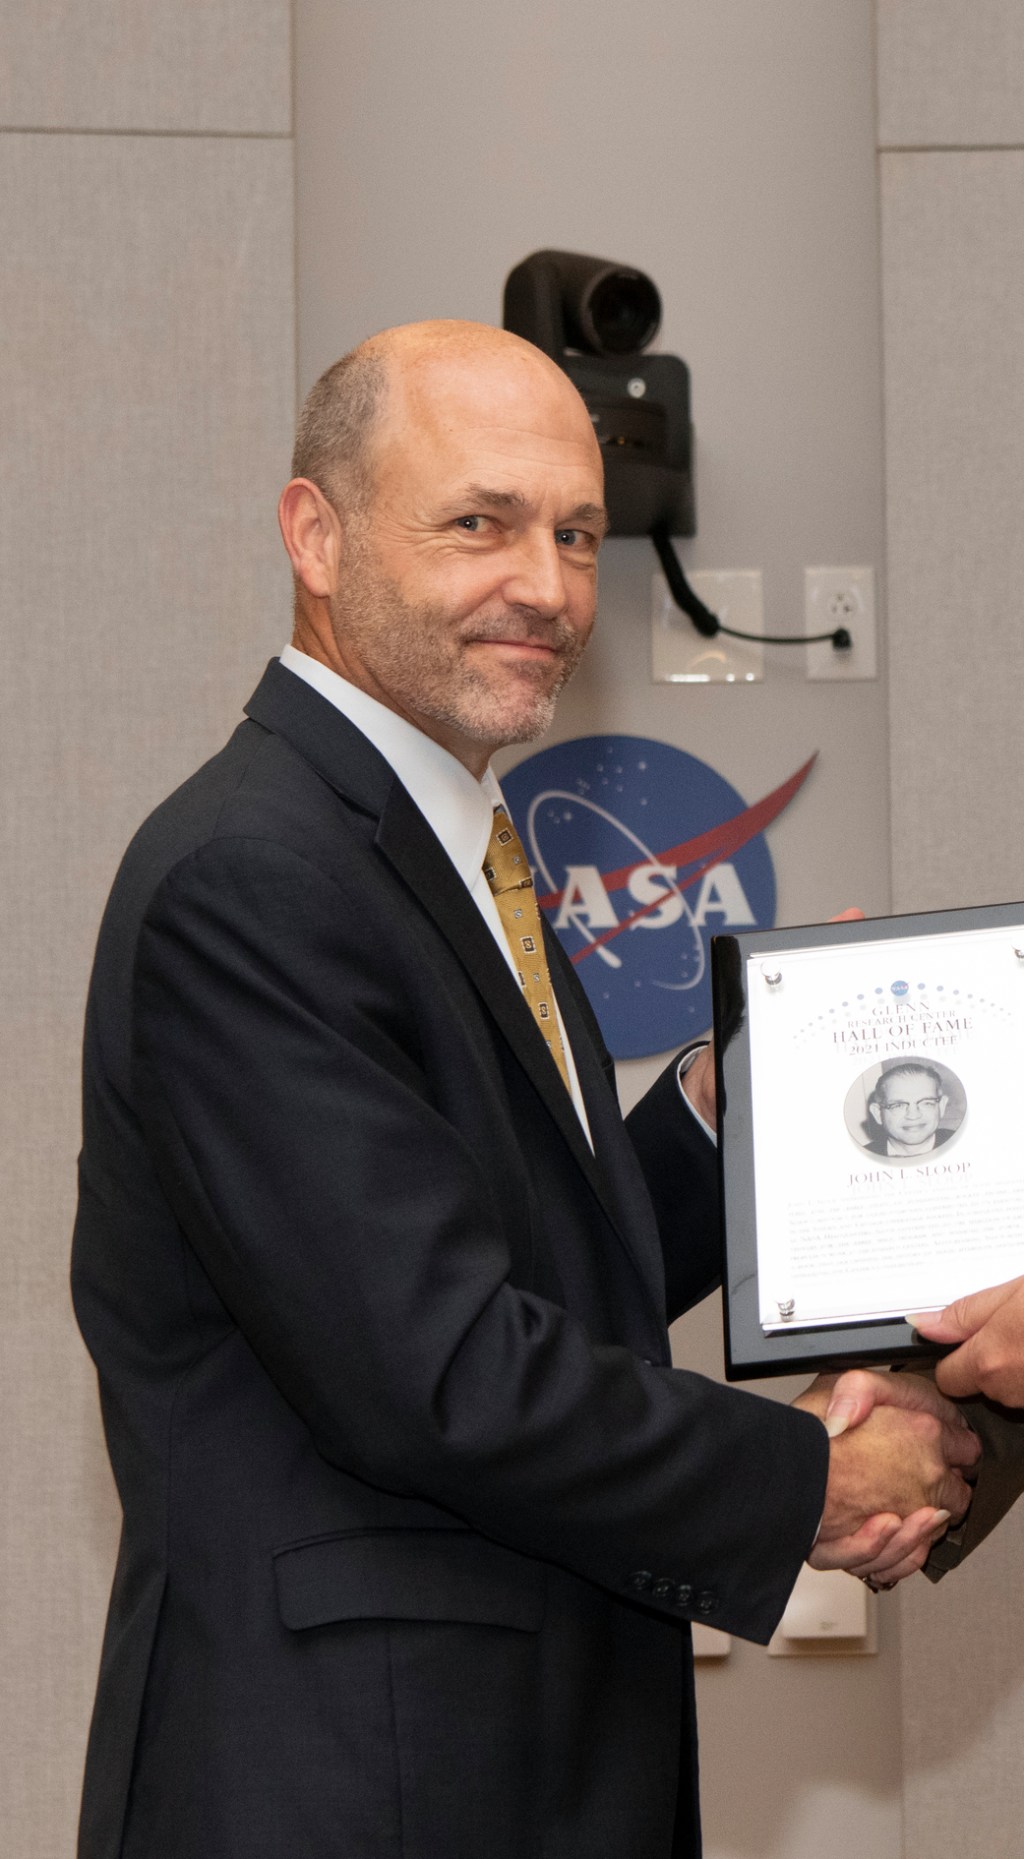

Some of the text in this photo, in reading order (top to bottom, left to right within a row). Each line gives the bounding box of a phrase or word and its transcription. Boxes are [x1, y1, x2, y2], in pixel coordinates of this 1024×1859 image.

[531, 863, 757, 929] ASA
[847, 1010, 957, 1028] RESEARCH CENTER
[872, 1001, 930, 1016] GLENN
[833, 1018, 973, 1043] HALL OF FAME
[885, 1036, 958, 1052] INDUCTEE
[848, 1170, 893, 1187] JOHN
[916, 1162, 971, 1177] SLOOP
